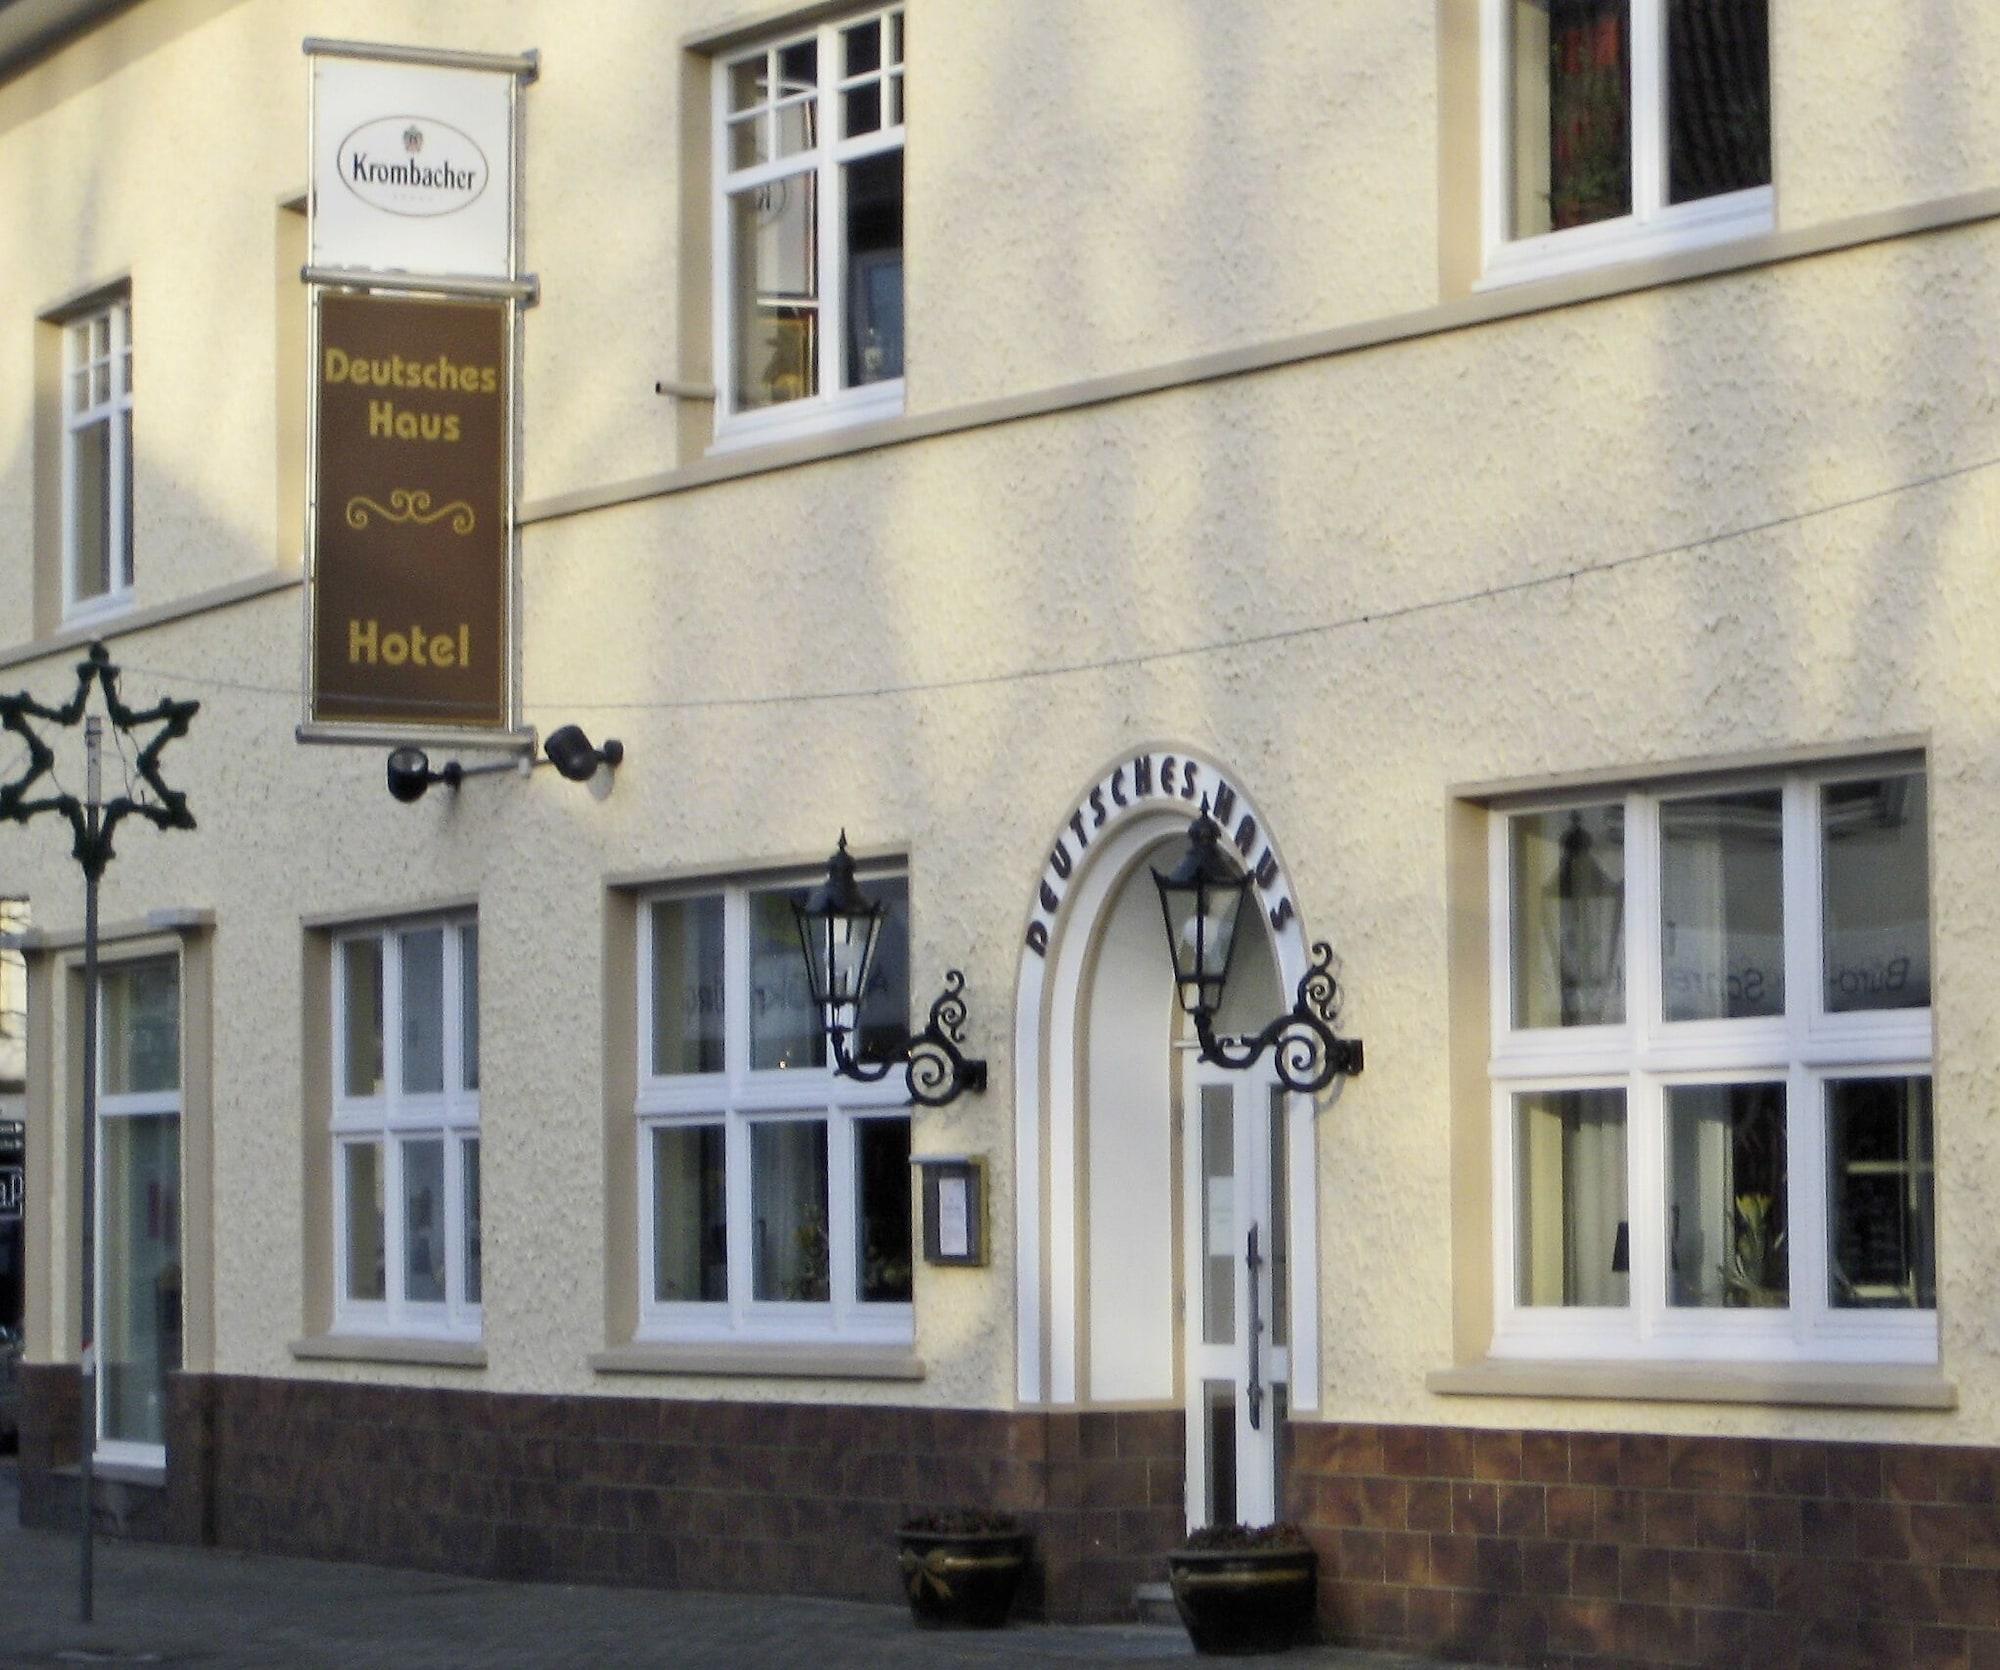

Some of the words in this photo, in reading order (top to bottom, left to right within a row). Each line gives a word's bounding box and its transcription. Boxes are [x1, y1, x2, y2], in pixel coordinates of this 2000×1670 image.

[353, 152, 475, 191] Krombacher
[325, 348, 497, 393] Deutsches
[368, 401, 460, 442] Haus
[349, 620, 470, 667] Hotel
[1026, 754, 1198, 957] DEUTSCHES
[1213, 779, 1293, 931] HAUS
